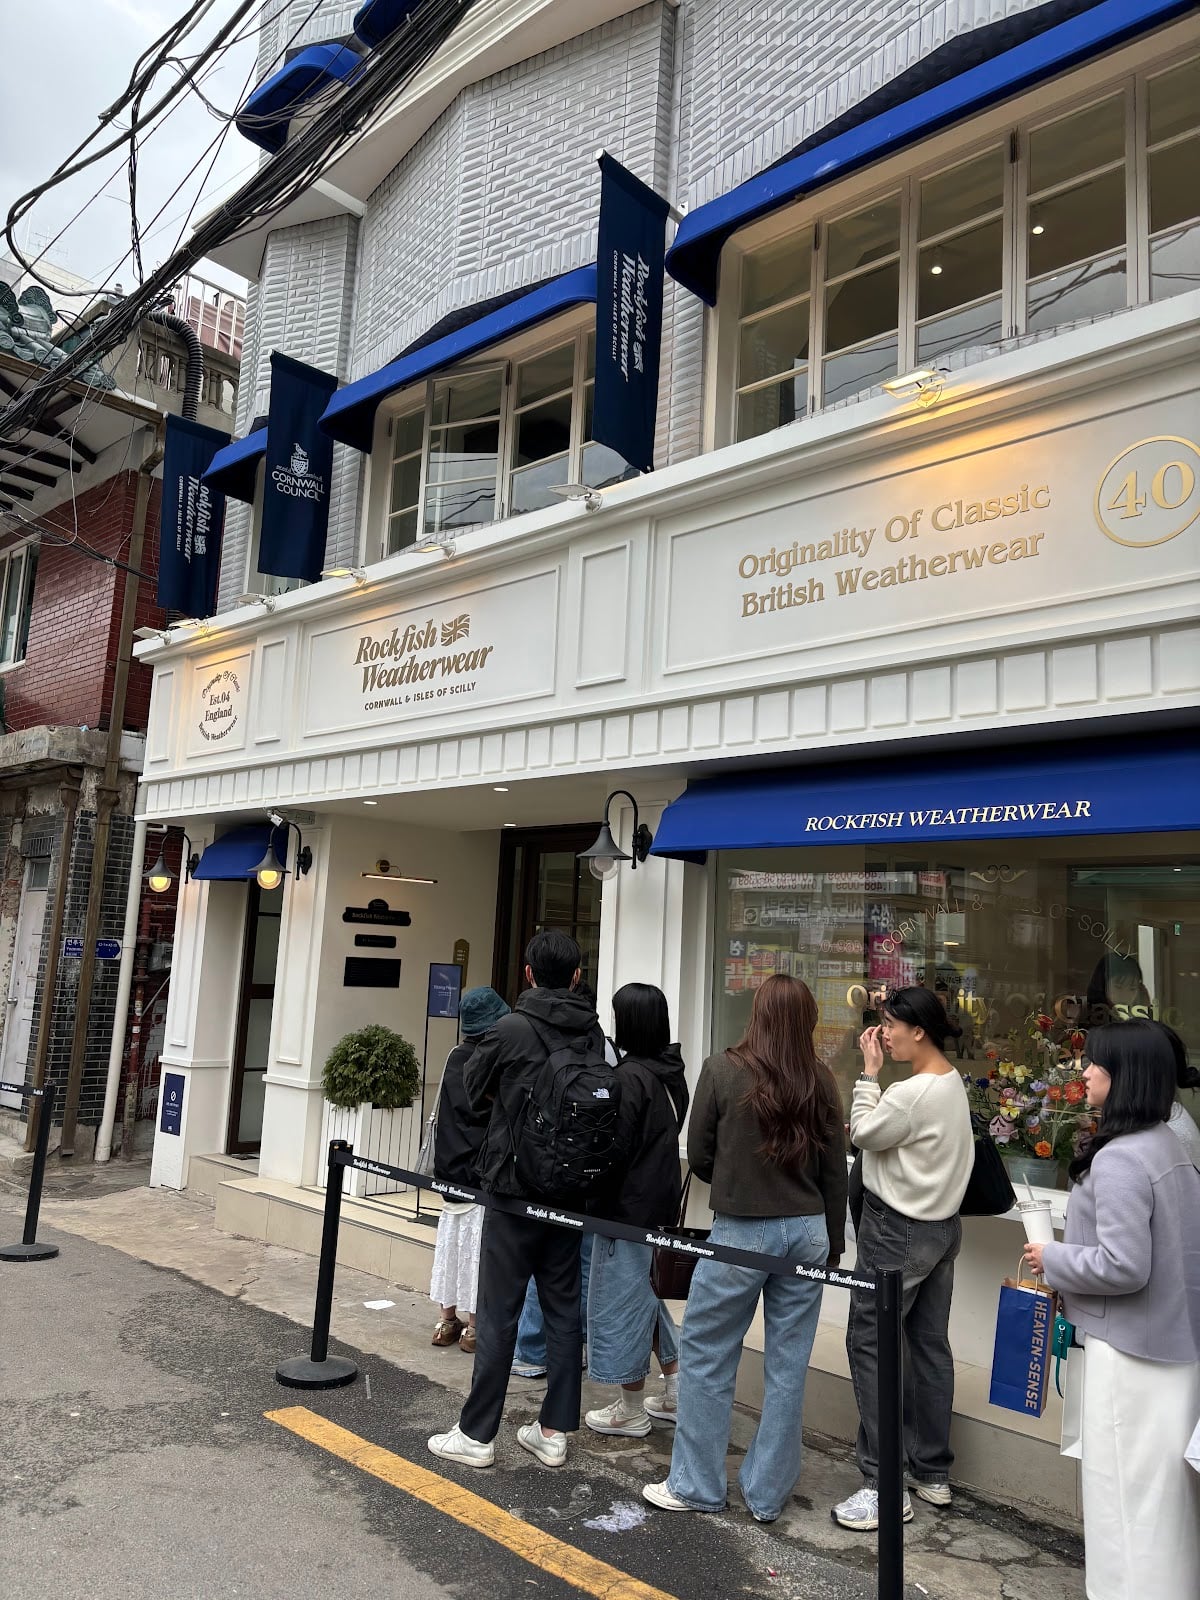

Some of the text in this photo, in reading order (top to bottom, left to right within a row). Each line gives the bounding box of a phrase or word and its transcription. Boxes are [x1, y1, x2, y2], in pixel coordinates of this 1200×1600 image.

[620, 252, 636, 383] Weatherwear
[634, 251, 650, 342] Rockfish
[271, 470, 325, 494] CORNWALL
[276, 482, 321, 502] COUNCIL
[1106, 461, 1196, 519] 40
[196, 483, 213, 534] ockfish
[738, 483, 1052, 579] Originality Of Classic
[741, 532, 1046, 618] British Weatherwear
[353, 618, 438, 665] Rockfish
[362, 645, 494, 694] Weatherwear
[204, 704, 233, 723] England
[364, 681, 477, 711] CORNWALL & ISLES OF SCILLY
[804, 799, 1092, 833] ROCKFISH WEATHERWEAR
[1077, 913, 1138, 961] SCILLY
[645, 1233, 715, 1257] Rockfish Weatherwear
[795, 1264, 876, 1290] Rockfish Weatherwea
